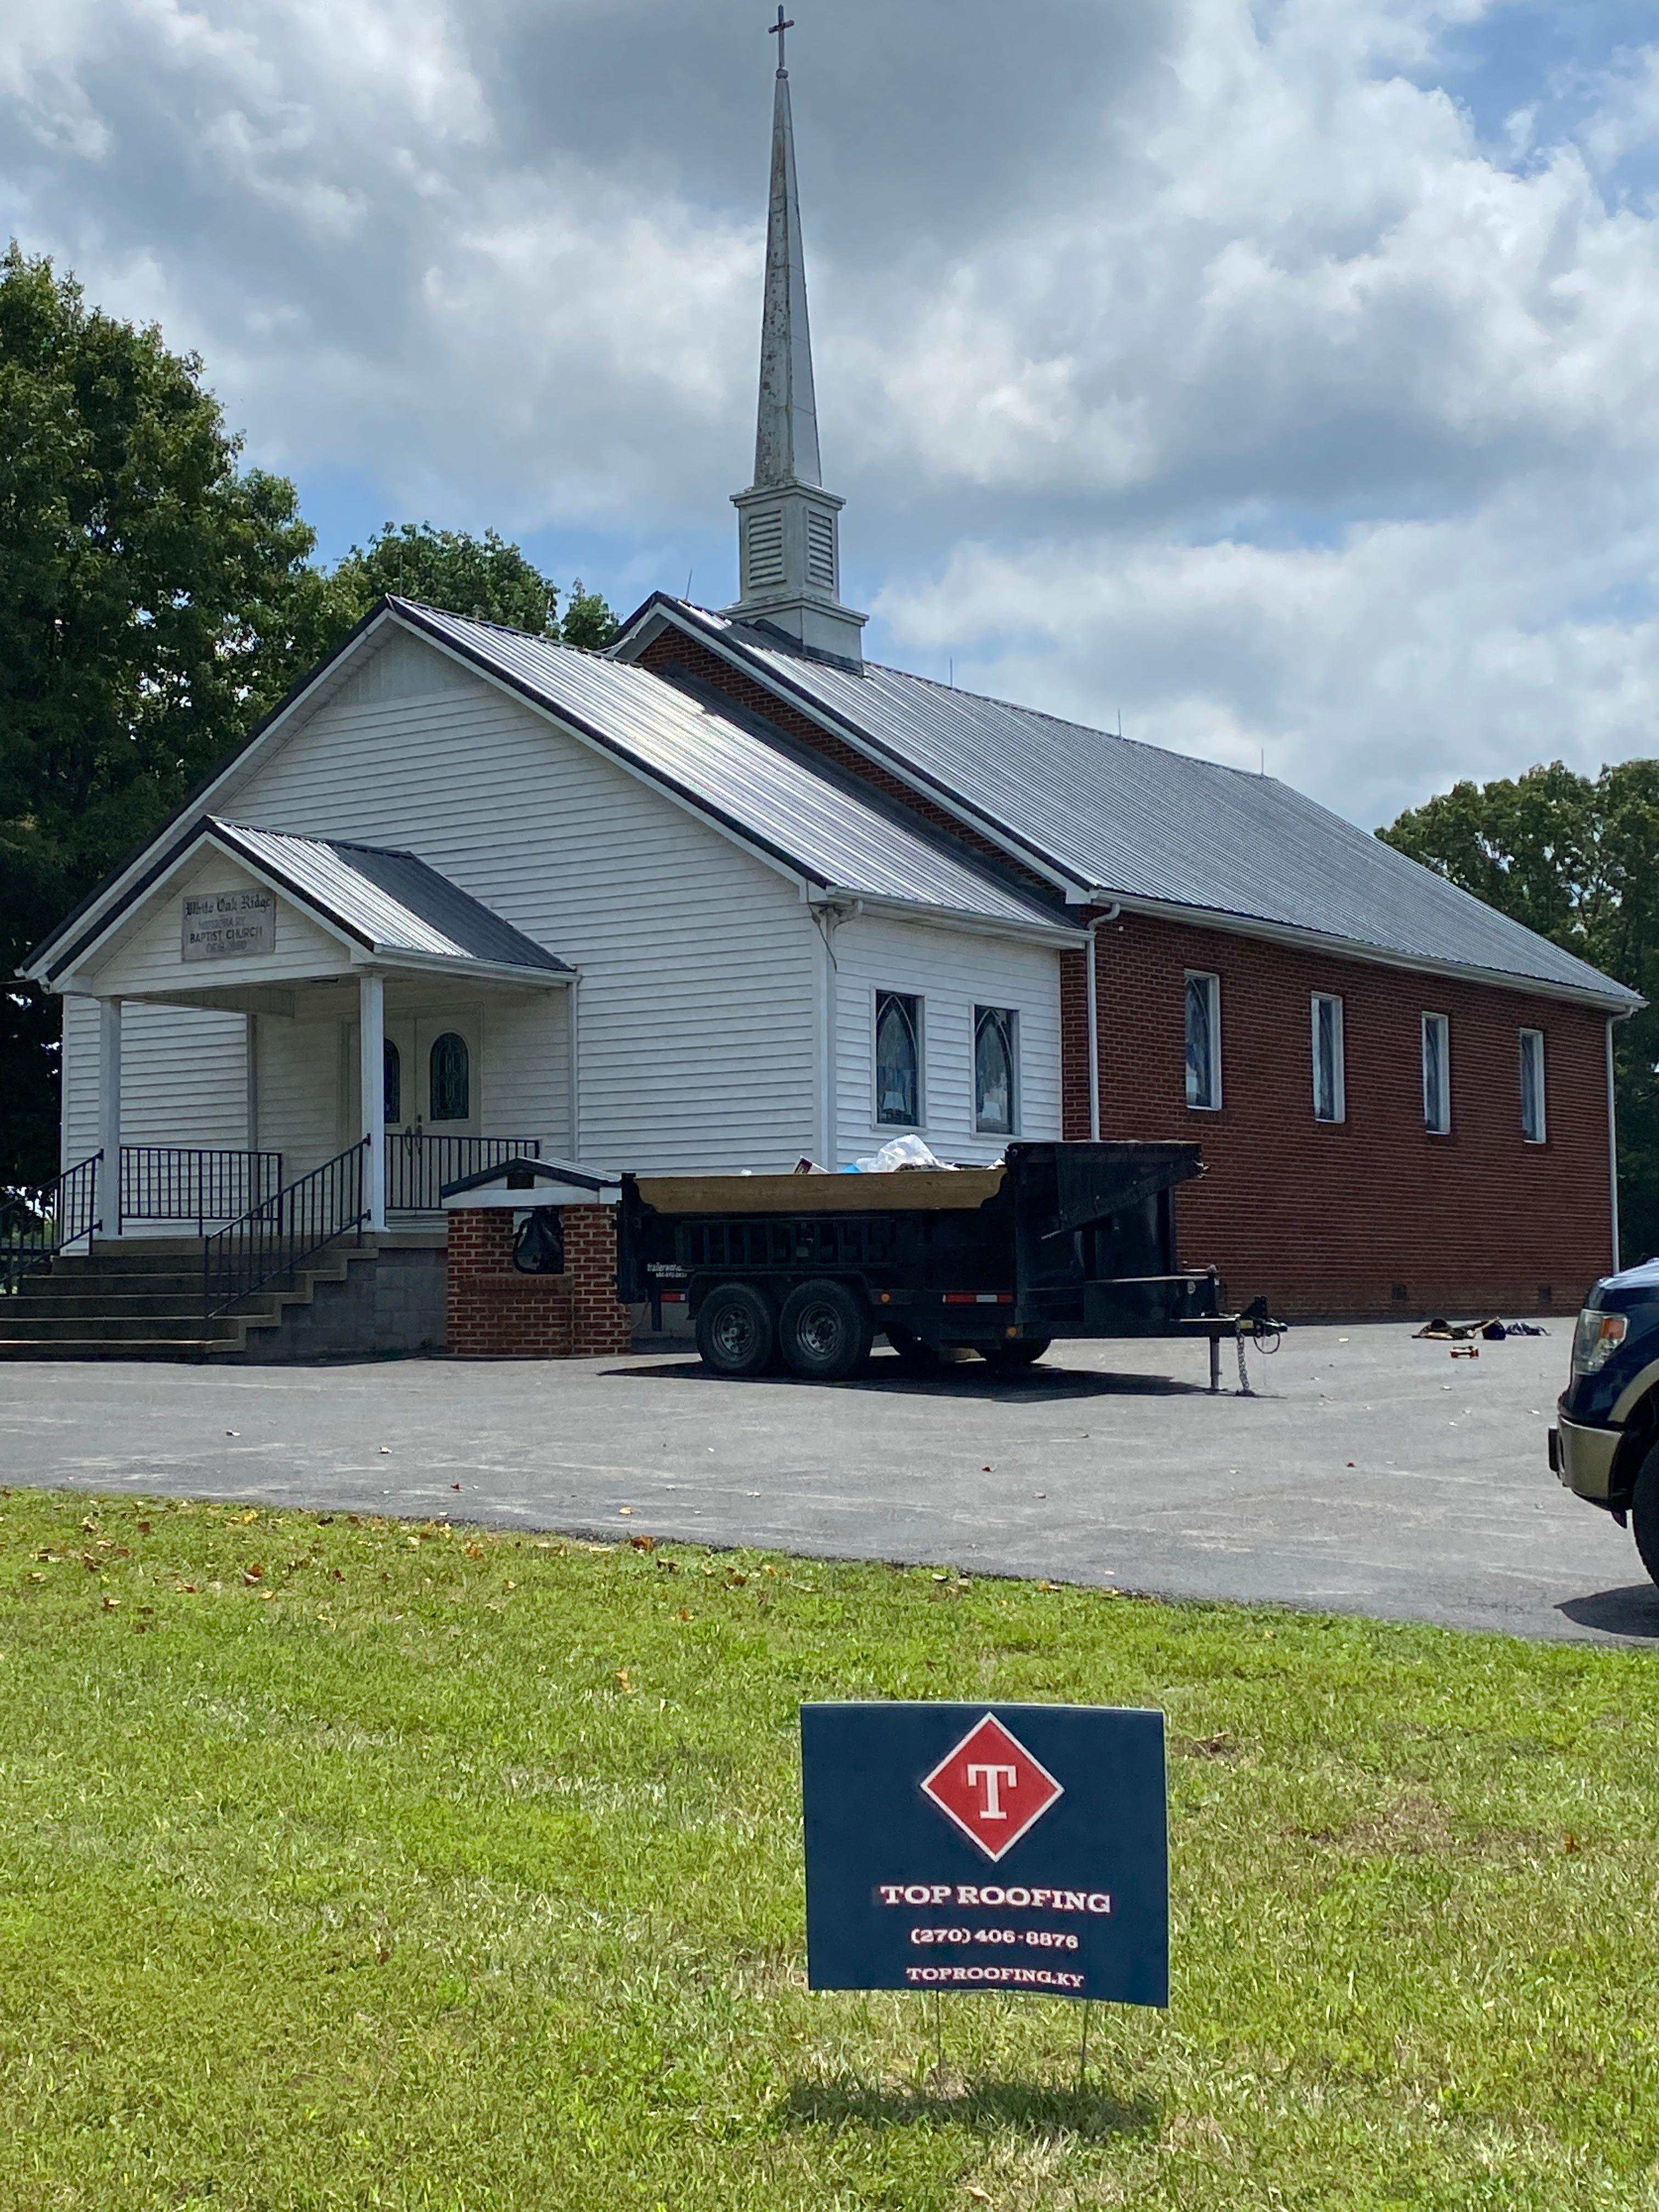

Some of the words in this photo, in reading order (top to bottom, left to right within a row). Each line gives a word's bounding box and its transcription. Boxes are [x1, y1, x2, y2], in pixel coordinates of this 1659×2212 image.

[190, 930, 222, 944] BAPTIST
[226, 926, 262, 940] CHURCH
[967, 1764, 1017, 1819] T
[880, 1886, 952, 1904] TOP
[956, 1886, 1111, 1913] ROOFING
[911, 1928, 970, 1944] (270)
[974, 1929, 1079, 1949] 406-8876
[906, 1967, 1085, 1988] TOPROOFING.KY
